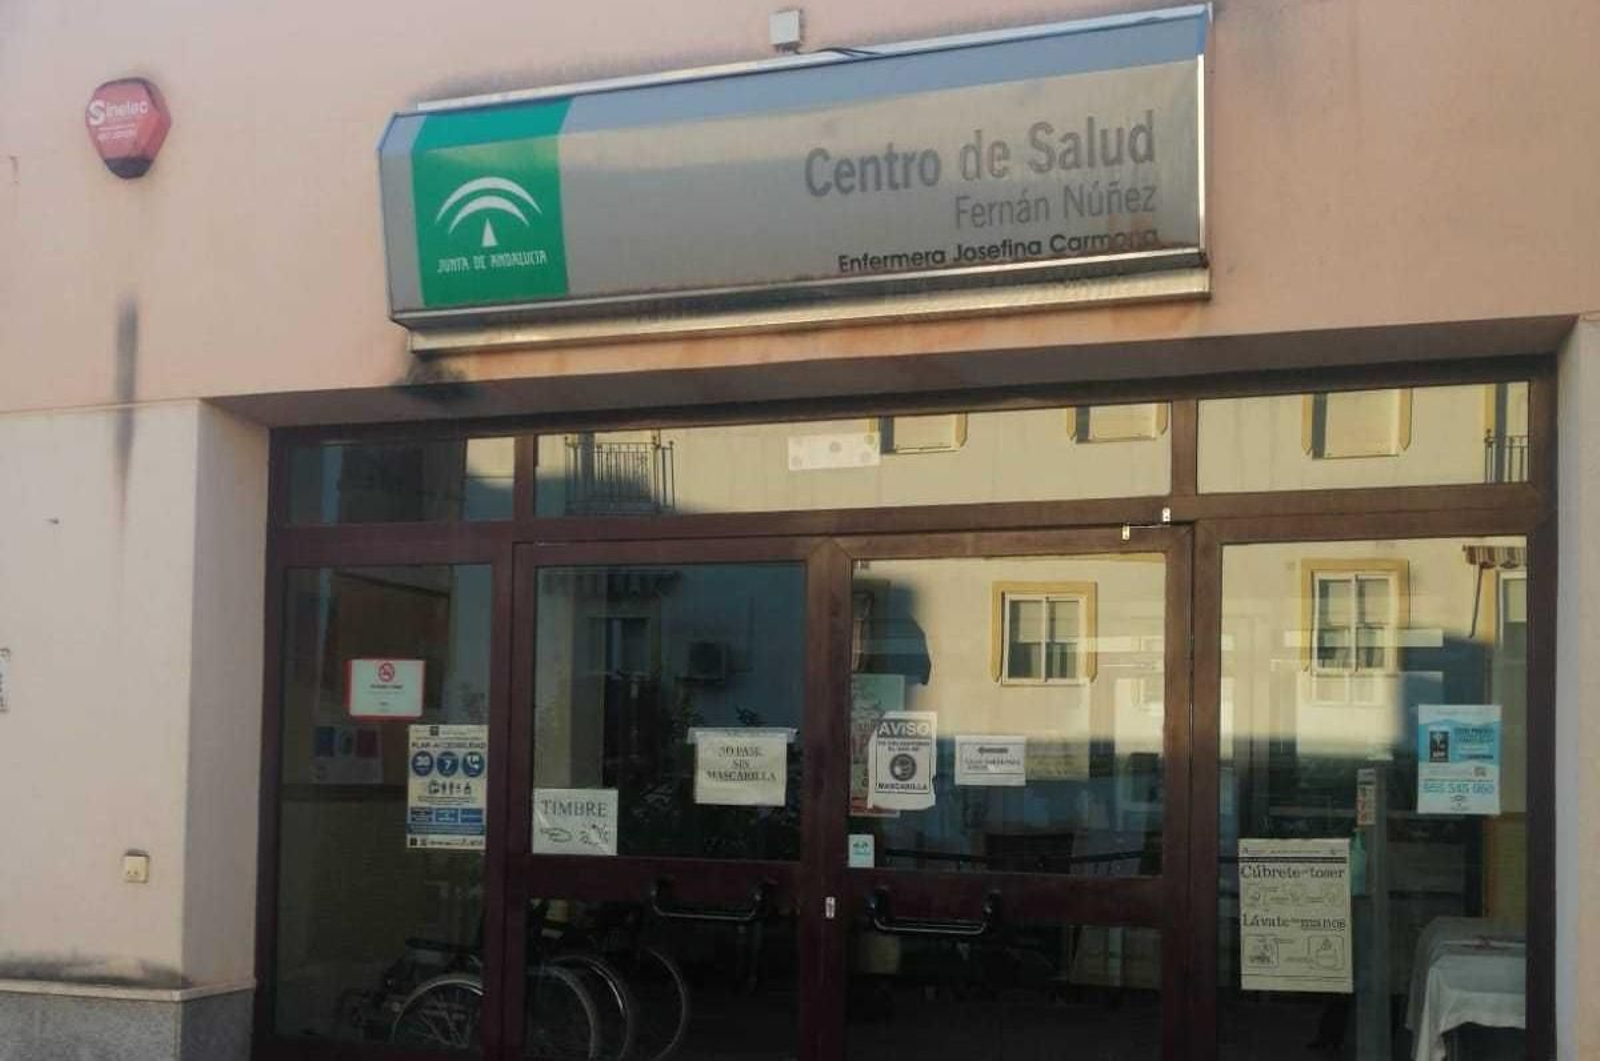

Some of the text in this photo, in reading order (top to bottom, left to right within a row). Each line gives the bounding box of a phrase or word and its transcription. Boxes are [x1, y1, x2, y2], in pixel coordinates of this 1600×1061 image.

[804, 109, 1155, 198] Centro de Salud
[955, 180, 1158, 230] Fernán Núñez
[838, 228, 1159, 273] Enfermera Josefina Carmona
[437, 256, 470, 273] JUNTA
[474, 255, 486, 270] DE
[705, 770, 777, 783] MASCARILLA
[540, 799, 609, 818] TIMBRE
[1240, 863, 1301, 880] Cúbrete
[1242, 913, 1346, 930] Lávate manos
